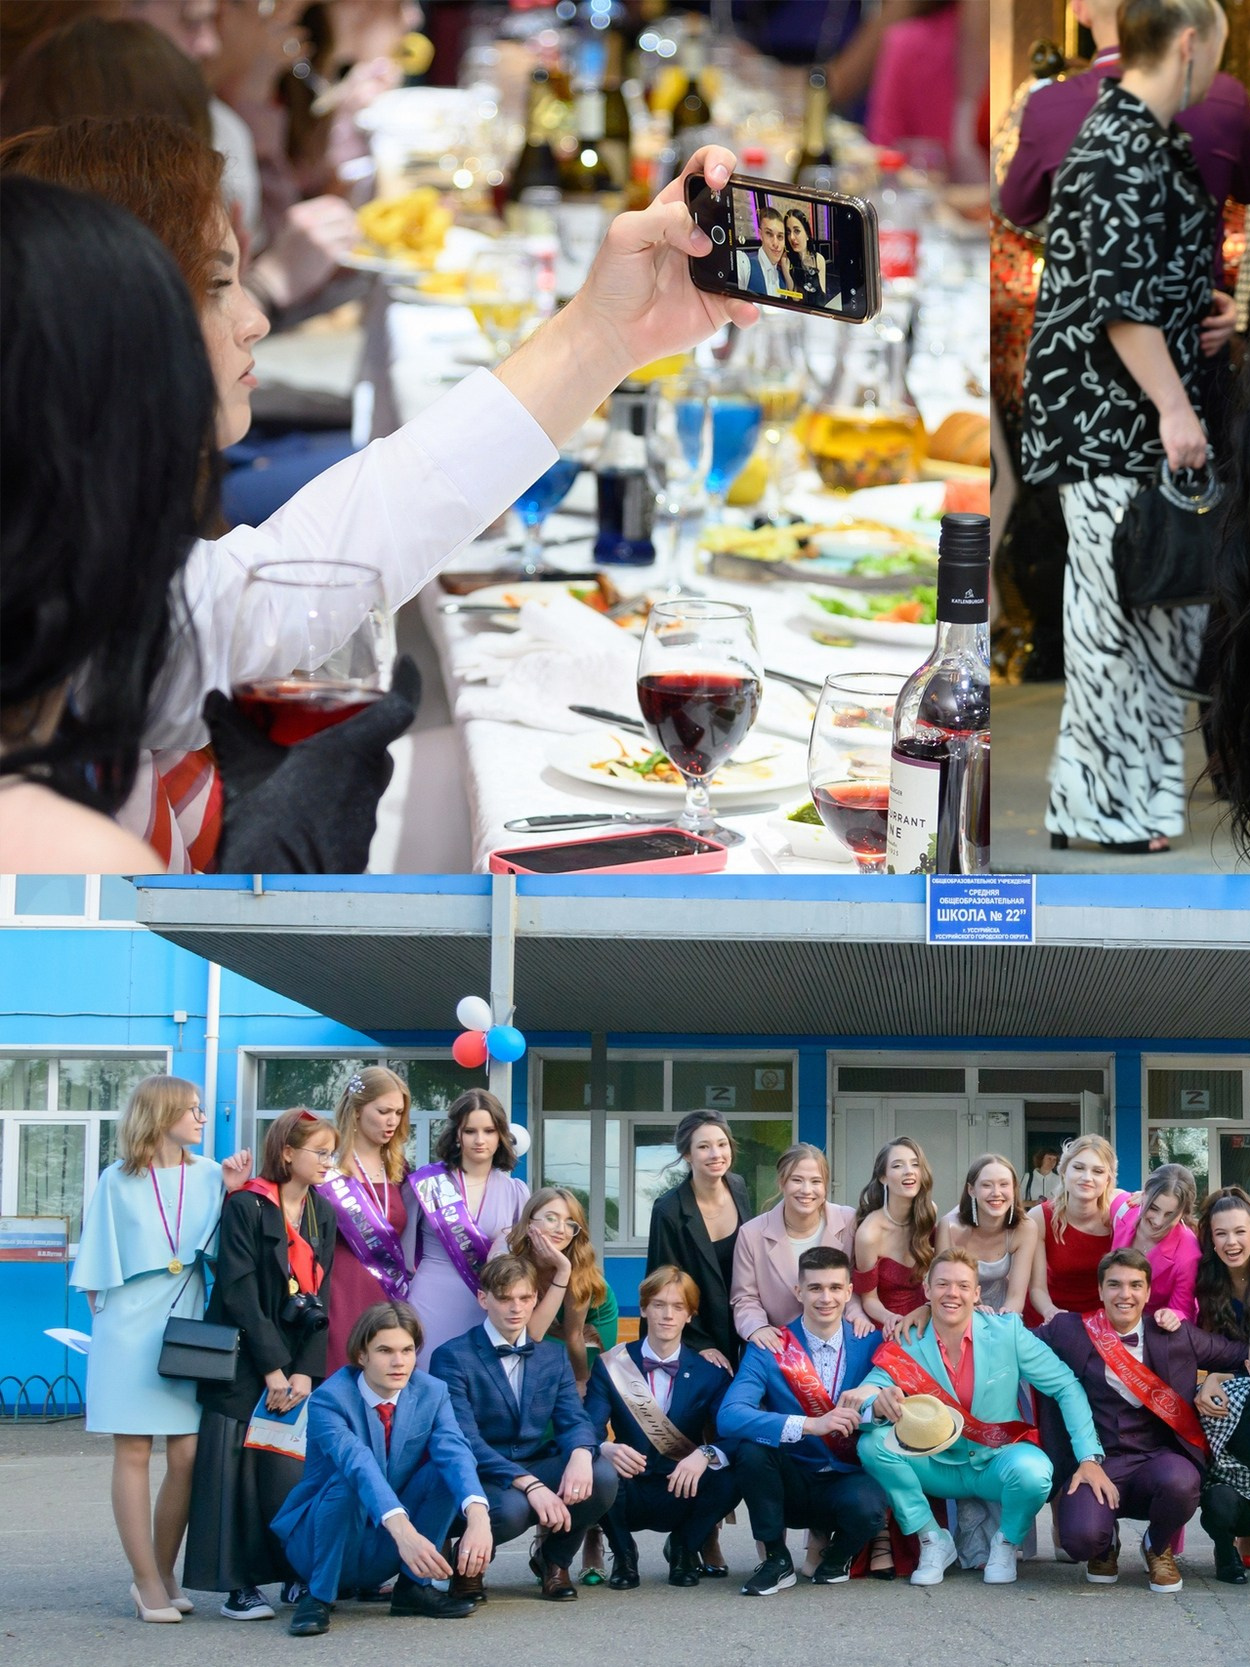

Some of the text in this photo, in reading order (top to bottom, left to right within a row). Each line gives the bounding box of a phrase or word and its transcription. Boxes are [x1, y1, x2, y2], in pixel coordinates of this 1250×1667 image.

[937, 909, 987, 922] ШКОЛА
[990, 911, 1003, 921] №
[331, 1178, 351, 1200] ЗА
